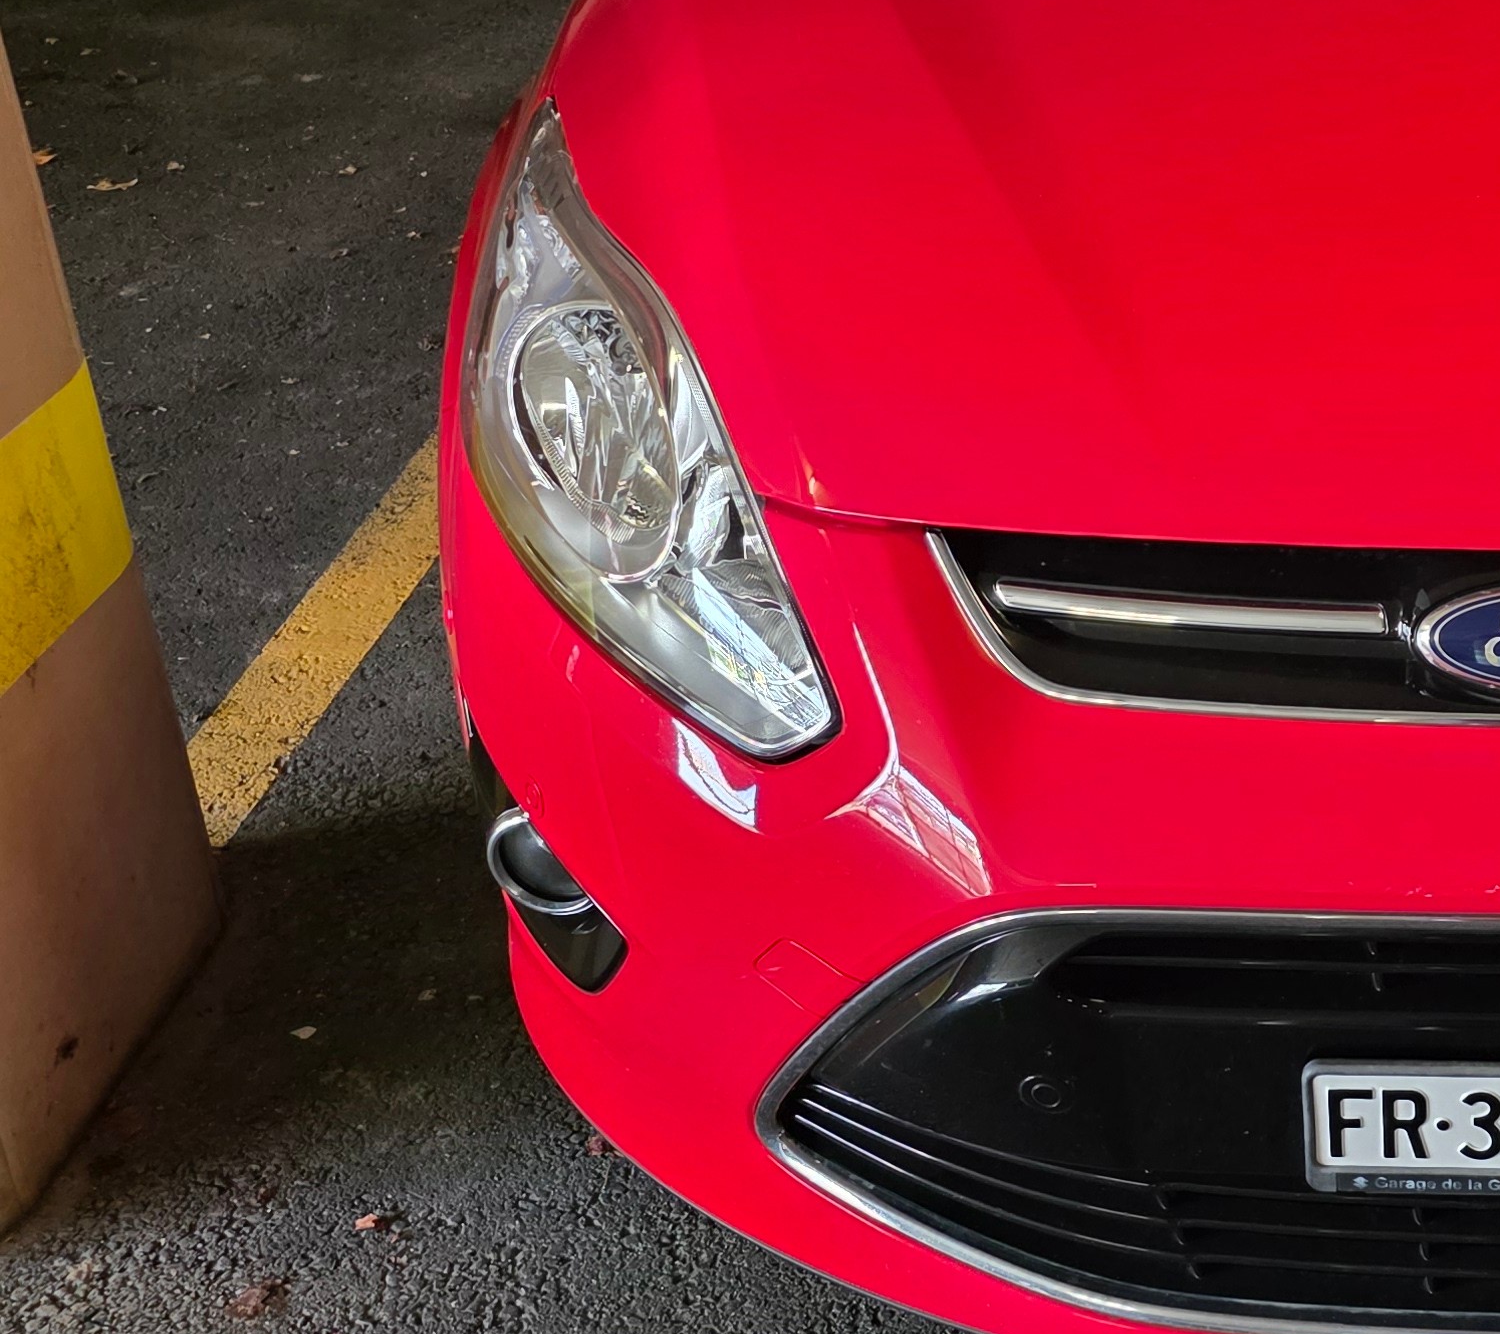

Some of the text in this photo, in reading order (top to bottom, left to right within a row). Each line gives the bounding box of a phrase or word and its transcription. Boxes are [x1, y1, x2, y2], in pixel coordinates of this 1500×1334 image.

[1374, 1176, 1436, 1192] Garage
[1441, 1178, 1462, 1191] de
[1467, 1178, 1483, 1191] la
